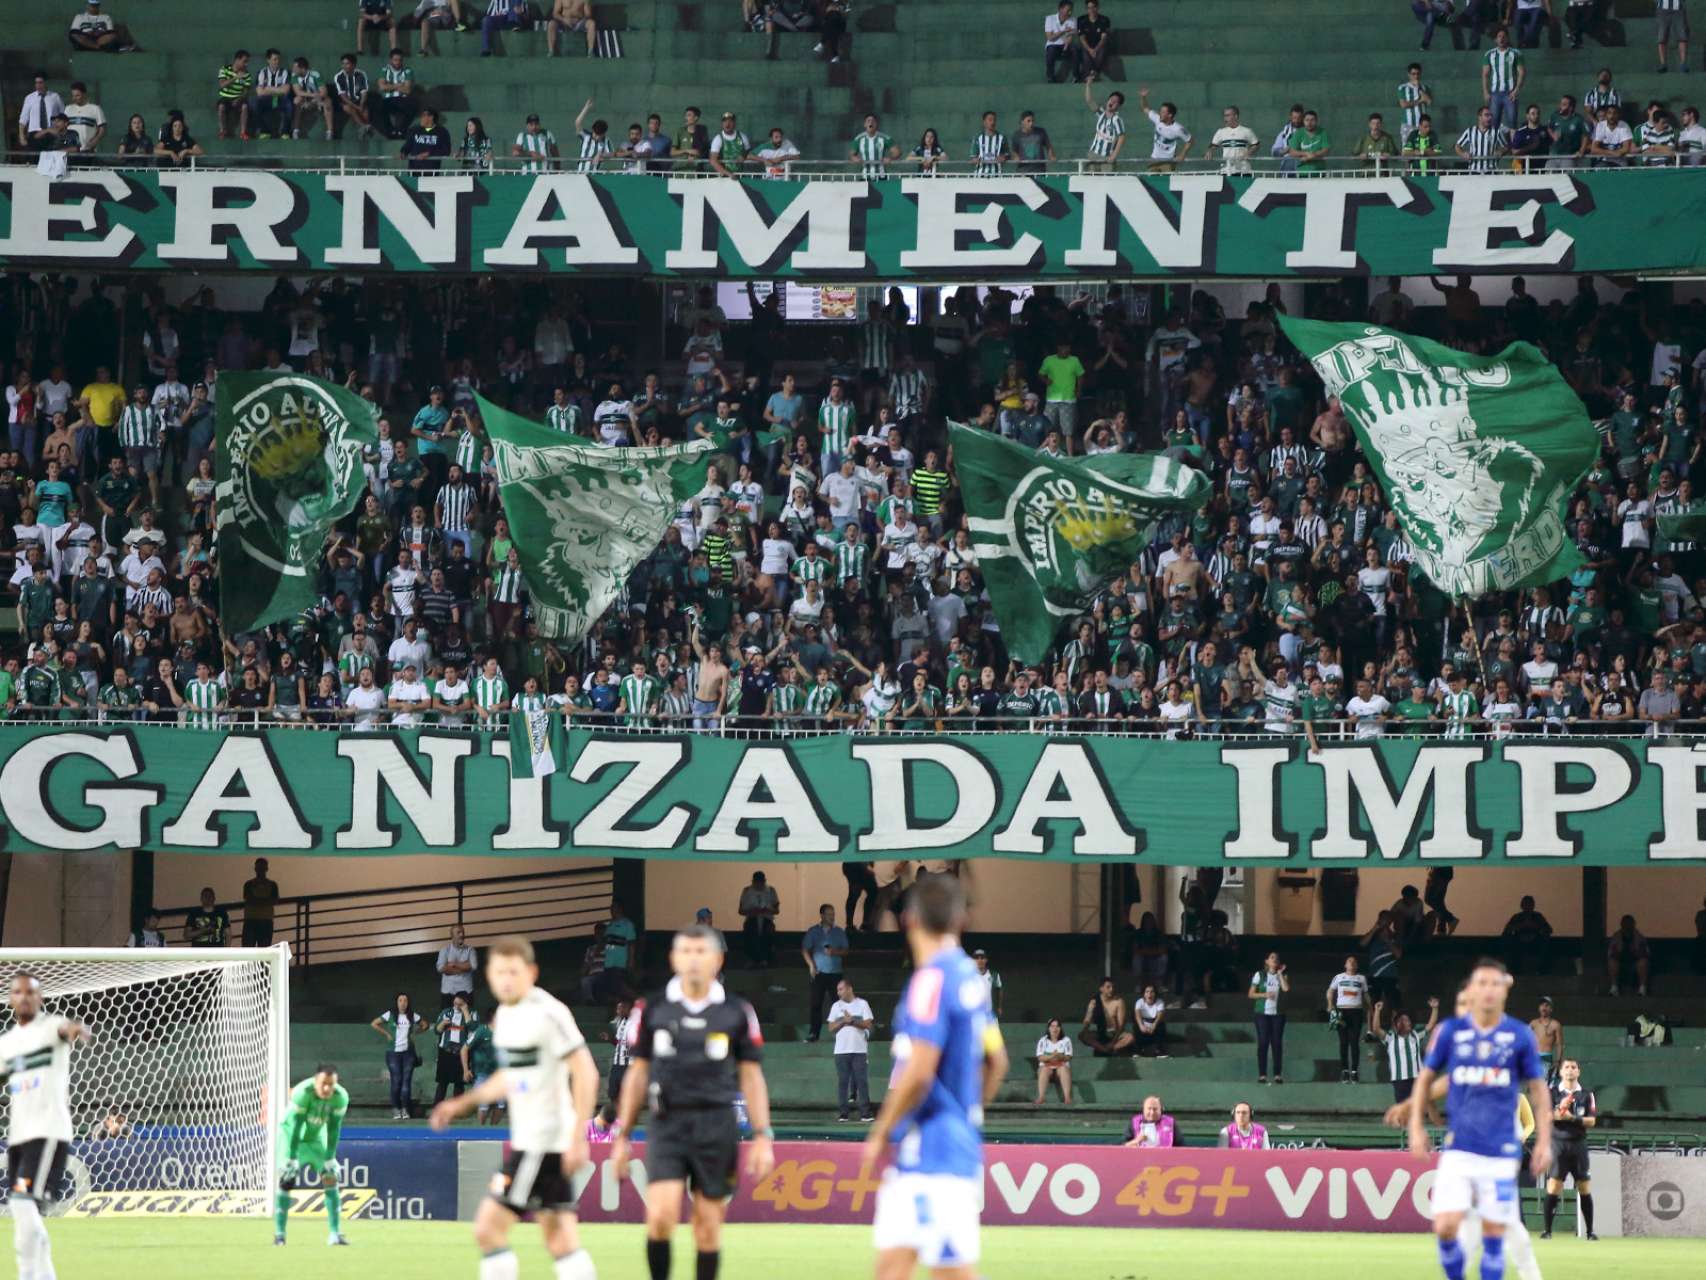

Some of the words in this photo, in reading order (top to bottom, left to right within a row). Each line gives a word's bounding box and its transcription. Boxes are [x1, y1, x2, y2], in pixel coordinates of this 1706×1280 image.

[0, 170, 1577, 269] ERNAMENTE
[978, 1161, 1101, 1216] VO
[1115, 1165, 1251, 1217] 4G+
